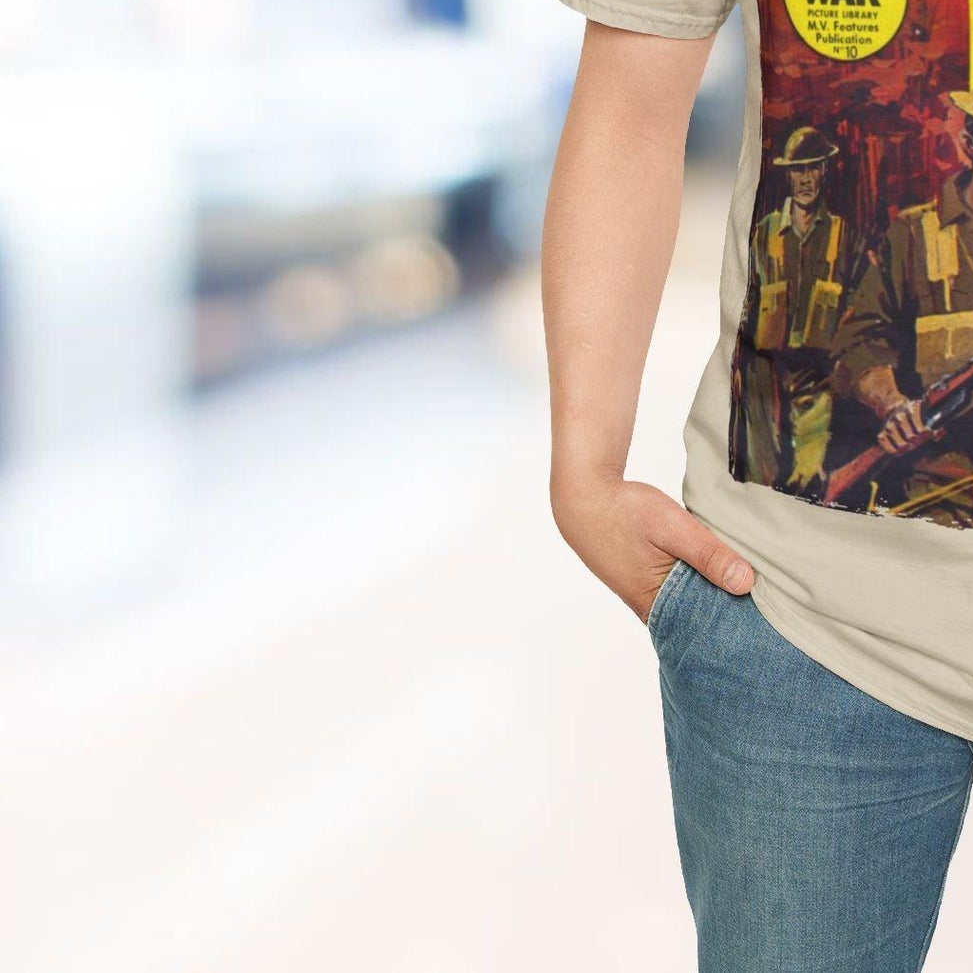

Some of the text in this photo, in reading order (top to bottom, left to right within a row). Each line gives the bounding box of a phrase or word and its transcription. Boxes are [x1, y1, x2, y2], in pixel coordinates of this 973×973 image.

[807, 9, 878, 20] PICTURE LIBRARY
[807, 20, 879, 32] M.V. Features
[815, 33, 872, 44] Publication
[845, 46, 858, 59] 10
